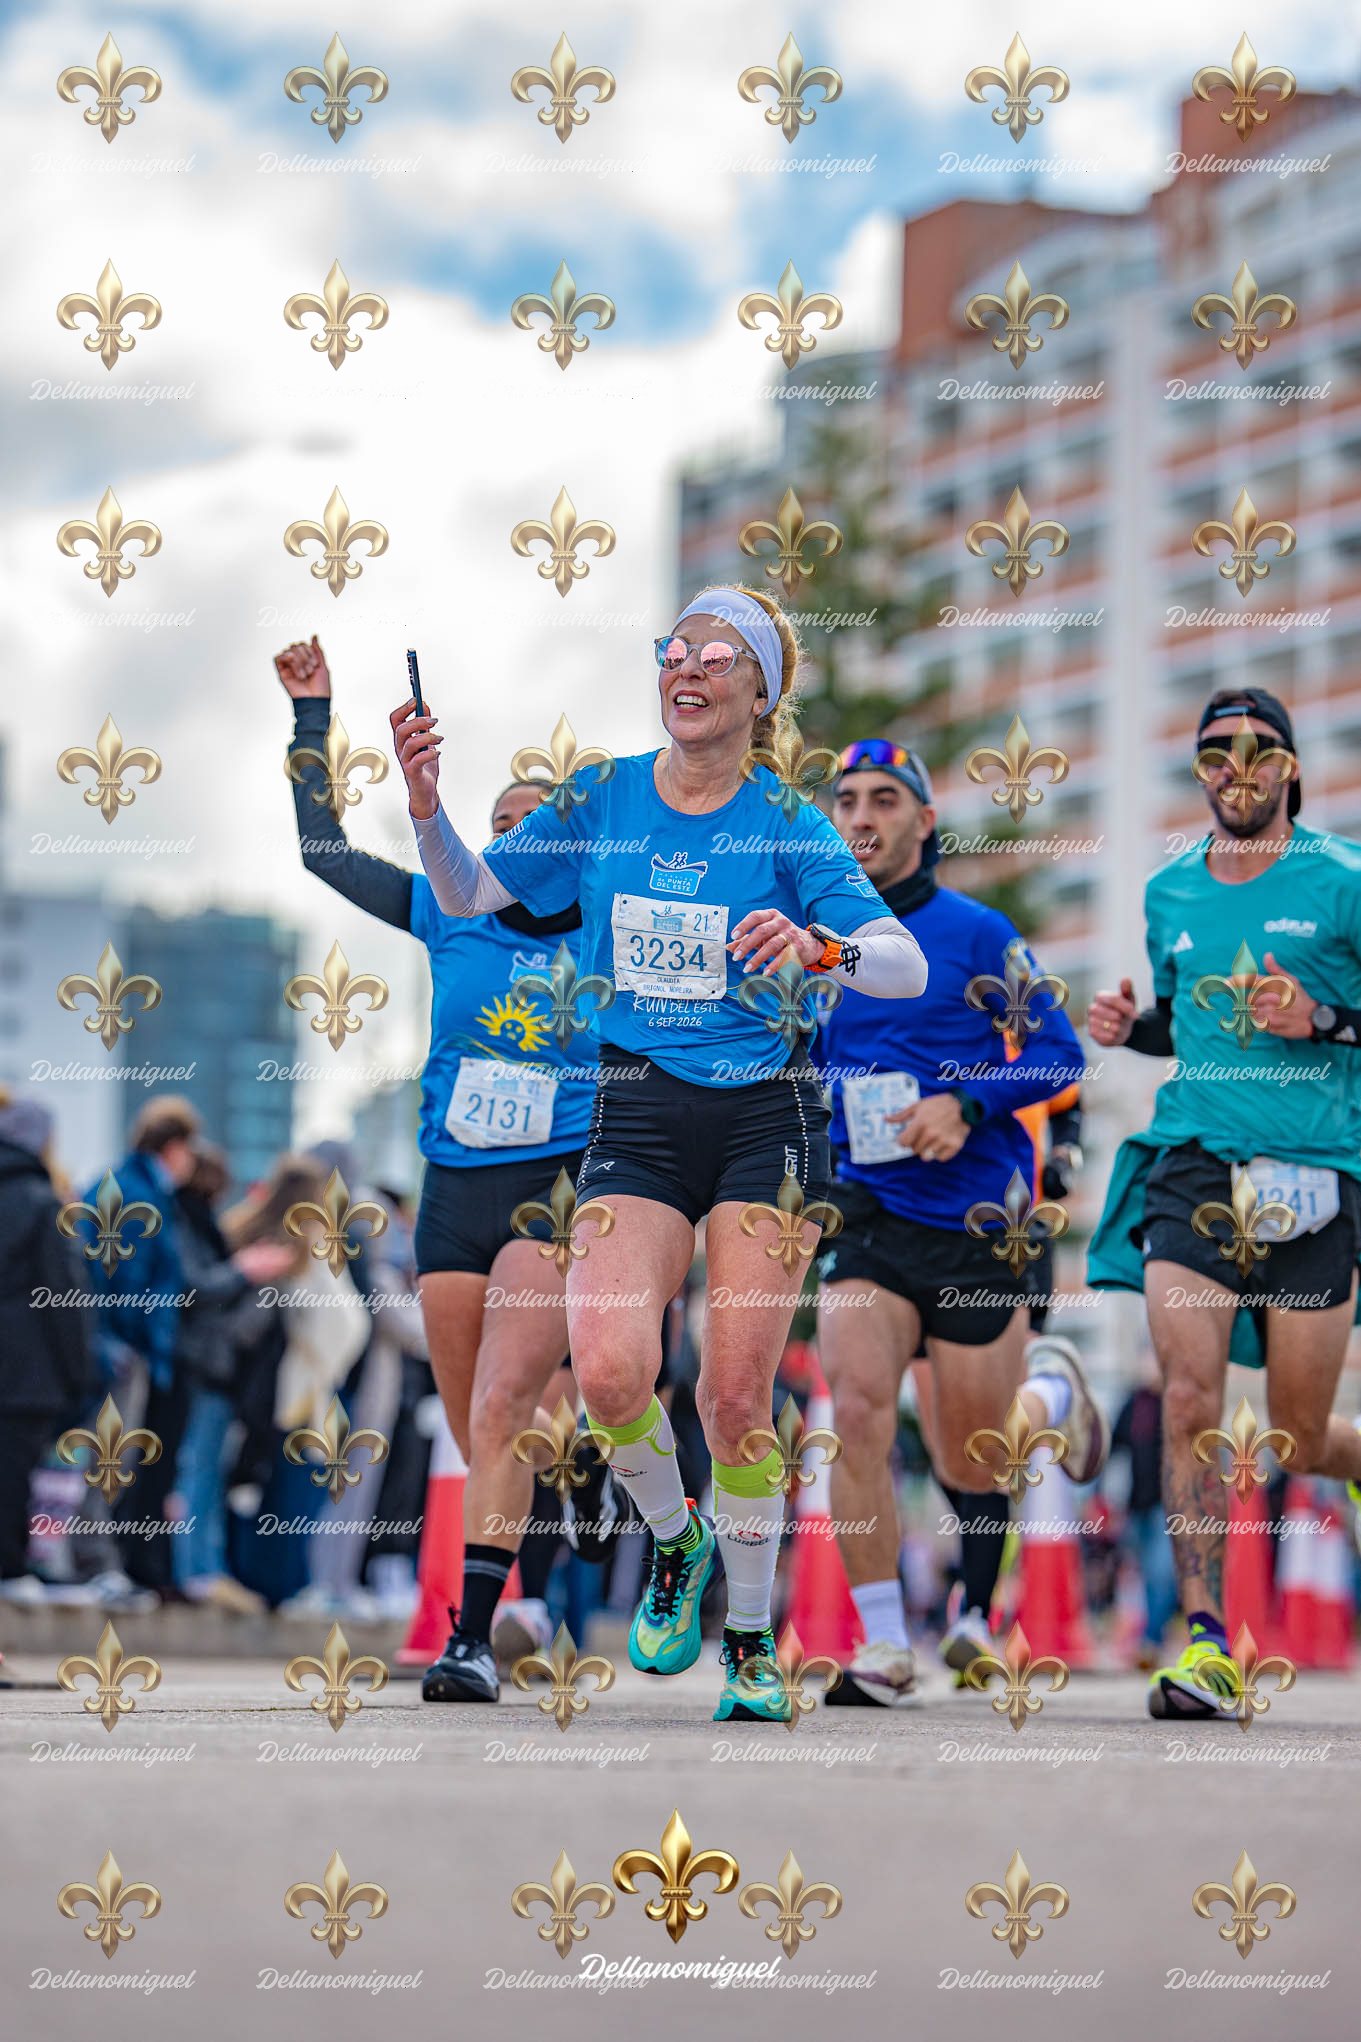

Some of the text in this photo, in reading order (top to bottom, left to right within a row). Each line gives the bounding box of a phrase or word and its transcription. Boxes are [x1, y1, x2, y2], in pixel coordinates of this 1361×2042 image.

[667, 878, 691, 887] PUNTA
[630, 934, 707, 971] 3234
[632, 994, 668, 1013] RUN
[669, 1001, 690, 1013] DEL
[693, 1002, 720, 1013] ESTE
[648, 1016, 703, 1027] 6 SEP 2026
[464, 1093, 533, 1134] 2131
